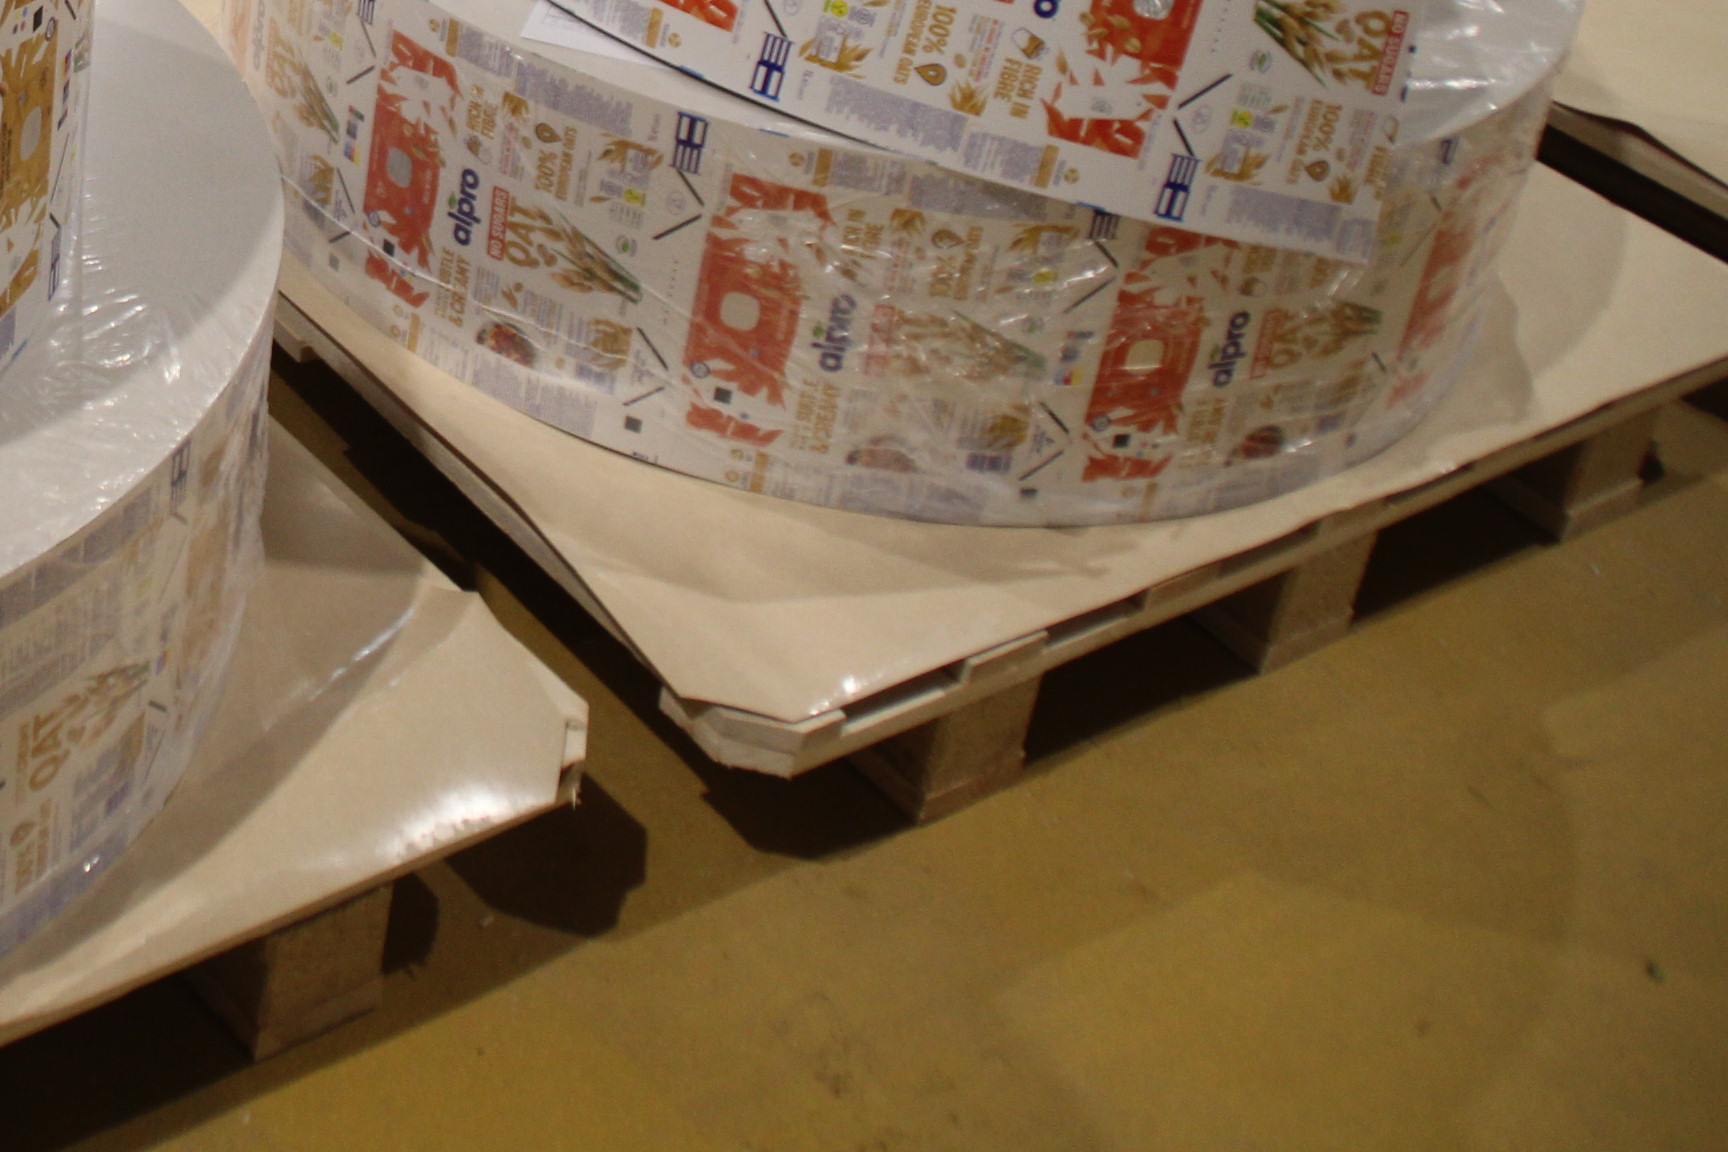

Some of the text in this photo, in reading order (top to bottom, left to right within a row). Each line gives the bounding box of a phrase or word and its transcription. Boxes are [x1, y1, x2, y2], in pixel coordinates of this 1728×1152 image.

[923, 4, 957, 54] 100%
[1349, 10, 1392, 91] OAT
[892, 56, 914, 85] OATS
[993, 57, 1023, 102] FIBRE
[1009, 63, 1043, 119] RICH IN
[447, 168, 481, 246] alpro
[489, 189, 509, 259] NO SUGARS
[505, 196, 538, 268] OAT
[437, 247, 454, 291] UBTLE
[1208, 311, 1251, 388] alpro
[28, 715, 67, 792] OAT
